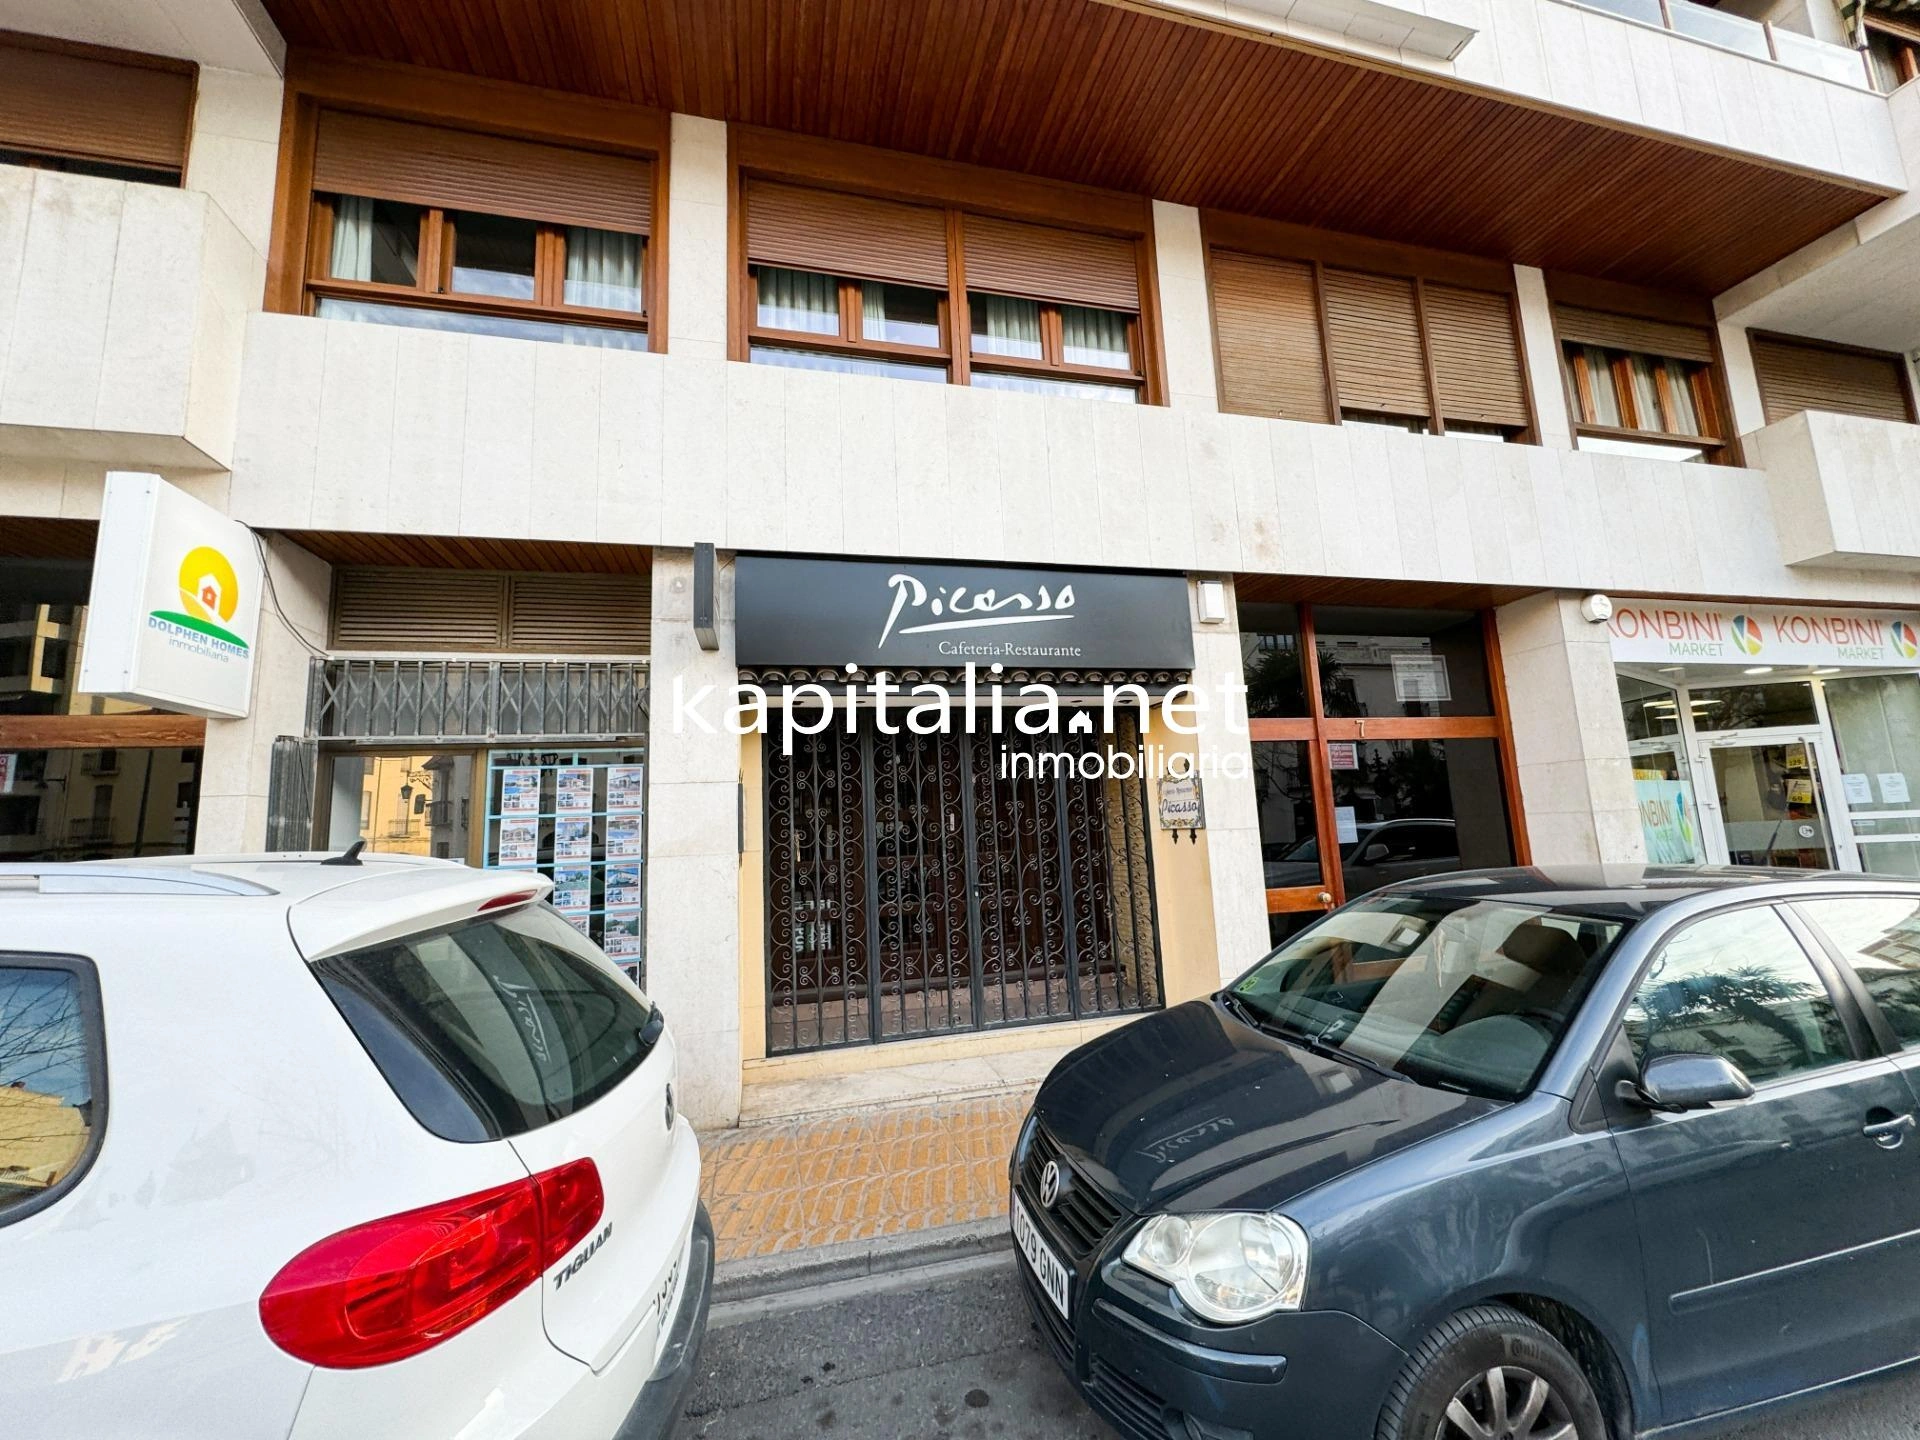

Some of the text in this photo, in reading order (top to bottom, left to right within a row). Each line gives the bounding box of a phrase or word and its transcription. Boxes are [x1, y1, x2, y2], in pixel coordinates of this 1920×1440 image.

[877, 573, 1076, 650] Picasso
[148, 617, 249, 660] DOLPHEN HOMES
[1773, 615, 1883, 645] KONBINI
[1669, 642, 1724, 657] MARKET
[1838, 647, 1884, 660] MARKET
[1354, 720, 1366, 738] 7
[1161, 798, 1198, 816] Picasso
[553, 1222, 613, 1290] TIGUAN
[1016, 1206, 1064, 1308] 1079 GNN
